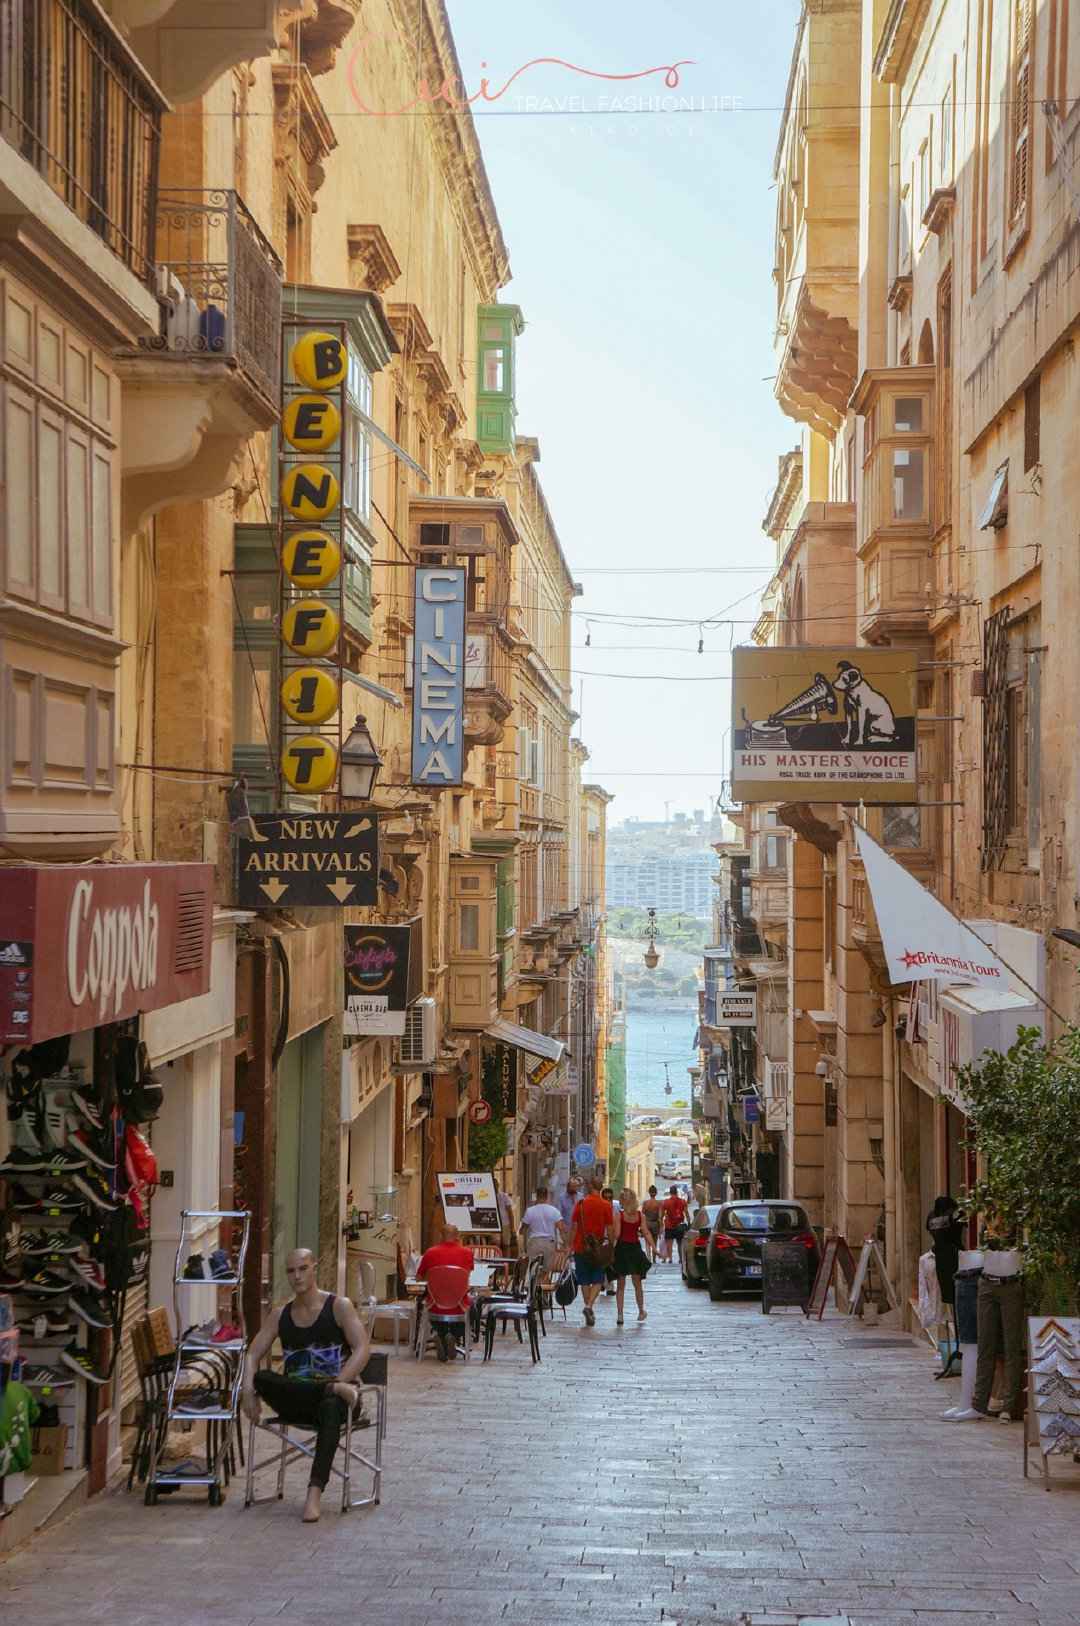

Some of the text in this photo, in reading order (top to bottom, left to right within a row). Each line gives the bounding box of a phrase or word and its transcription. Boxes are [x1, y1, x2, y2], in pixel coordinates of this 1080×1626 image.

[289, 339, 344, 785] BENEFIT
[419, 571, 459, 781] CINEMA
[740, 754, 909, 768] HIS MASTER'S VOICE
[279, 820, 340, 840] NEW
[245, 852, 372, 872] ARRIVALS
[67, 878, 160, 1021] Coppola
[918, 952, 968, 970] Britannia
[968, 960, 1000, 977] Tours
